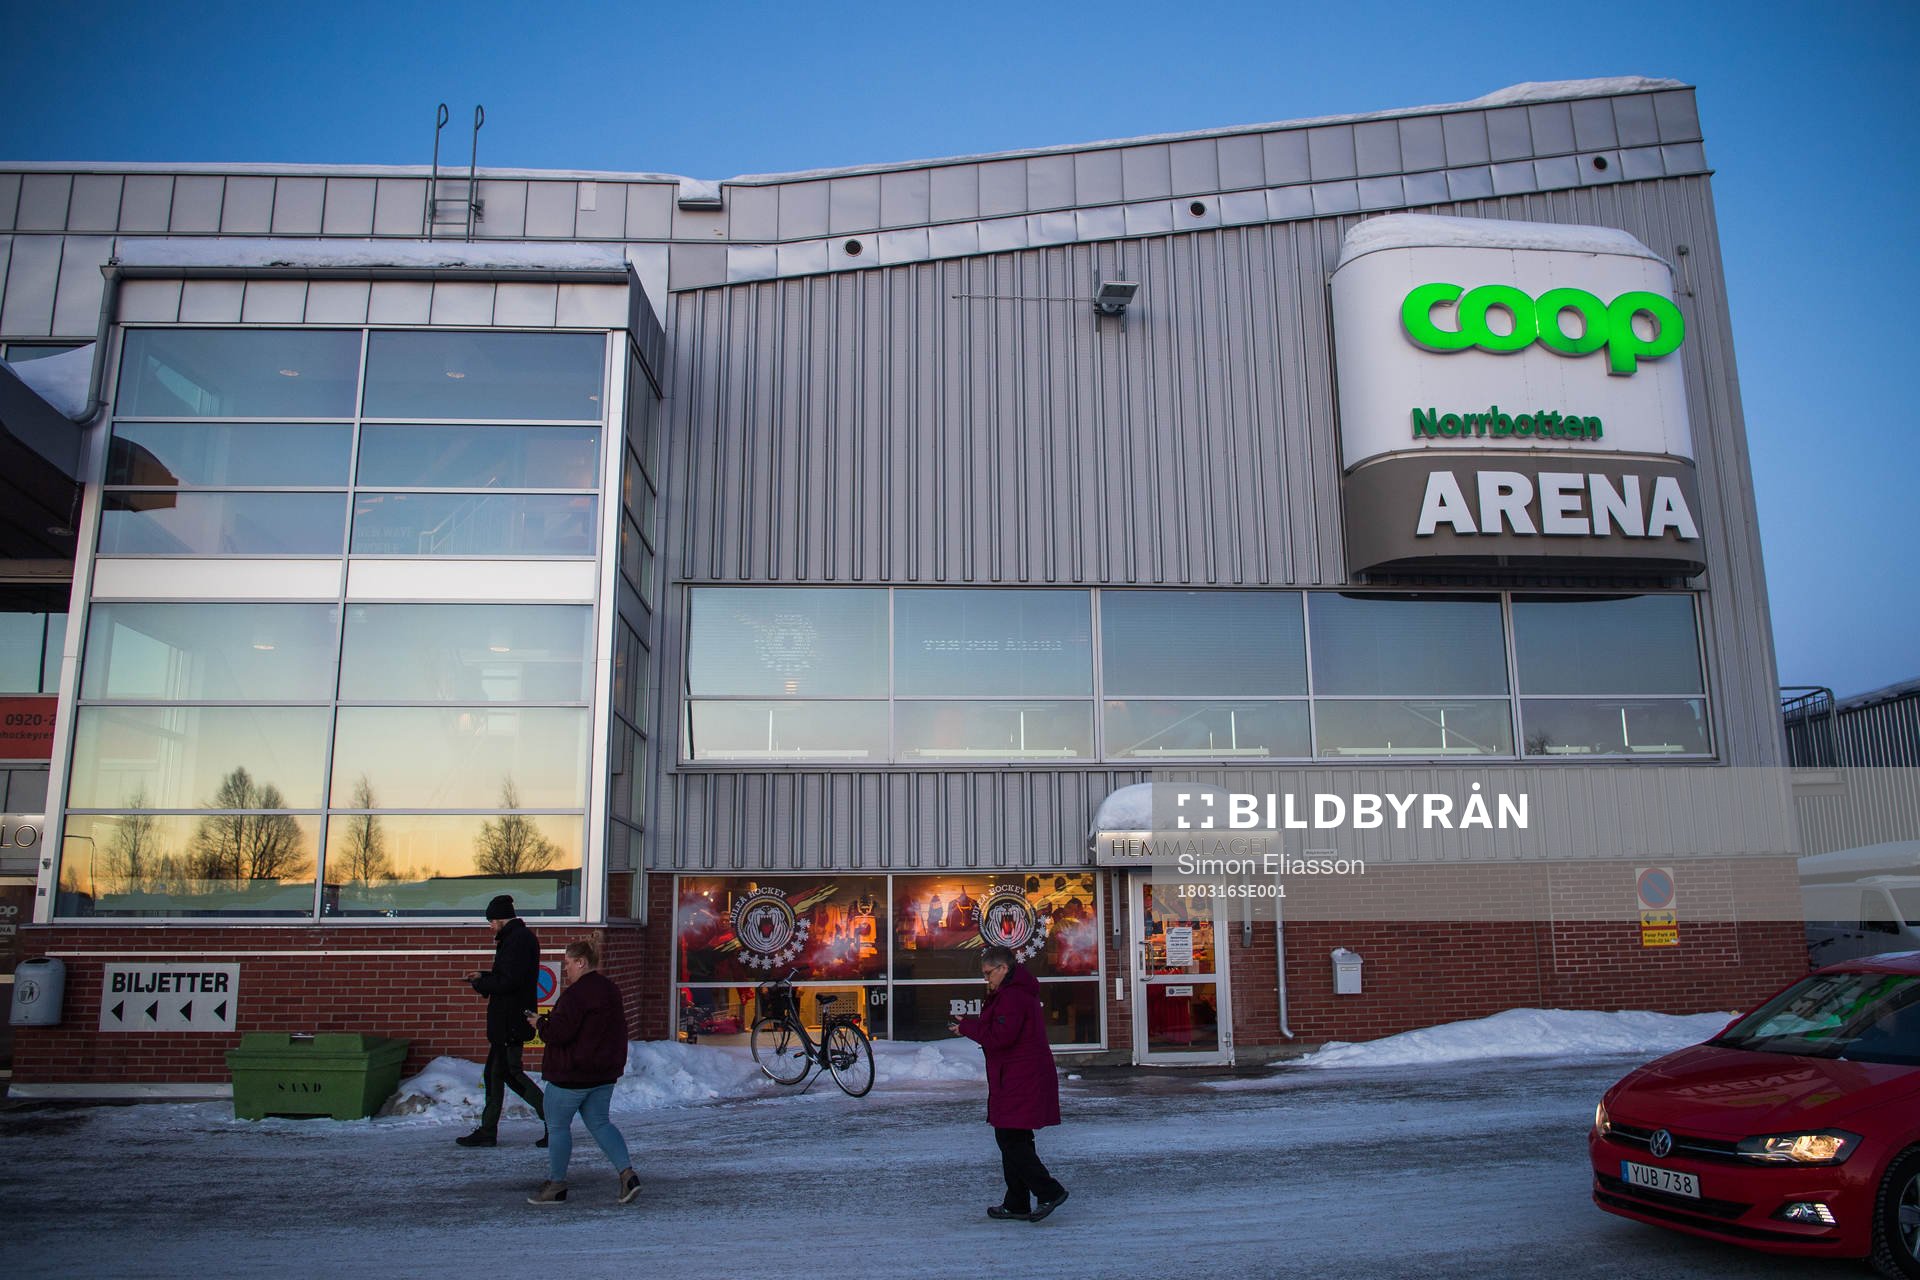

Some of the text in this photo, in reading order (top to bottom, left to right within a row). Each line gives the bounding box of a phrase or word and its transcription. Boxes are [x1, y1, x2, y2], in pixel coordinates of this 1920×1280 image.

[1401, 282, 1685, 376] coop
[1412, 405, 1603, 441] Norrbotten
[1416, 470, 1700, 540] ARENA
[0, 824, 43, 848] LO
[1111, 836, 1271, 857] HEMMALAGET
[988, 884, 1027, 896] HOCKEY
[729, 886, 788, 924] LULEÅ HOCKEY
[111, 972, 229, 993] BILJETTER
[950, 999, 984, 1016] Bil
[277, 1082, 322, 1093] SAND
[1631, 1164, 1693, 1194] YUB 738
